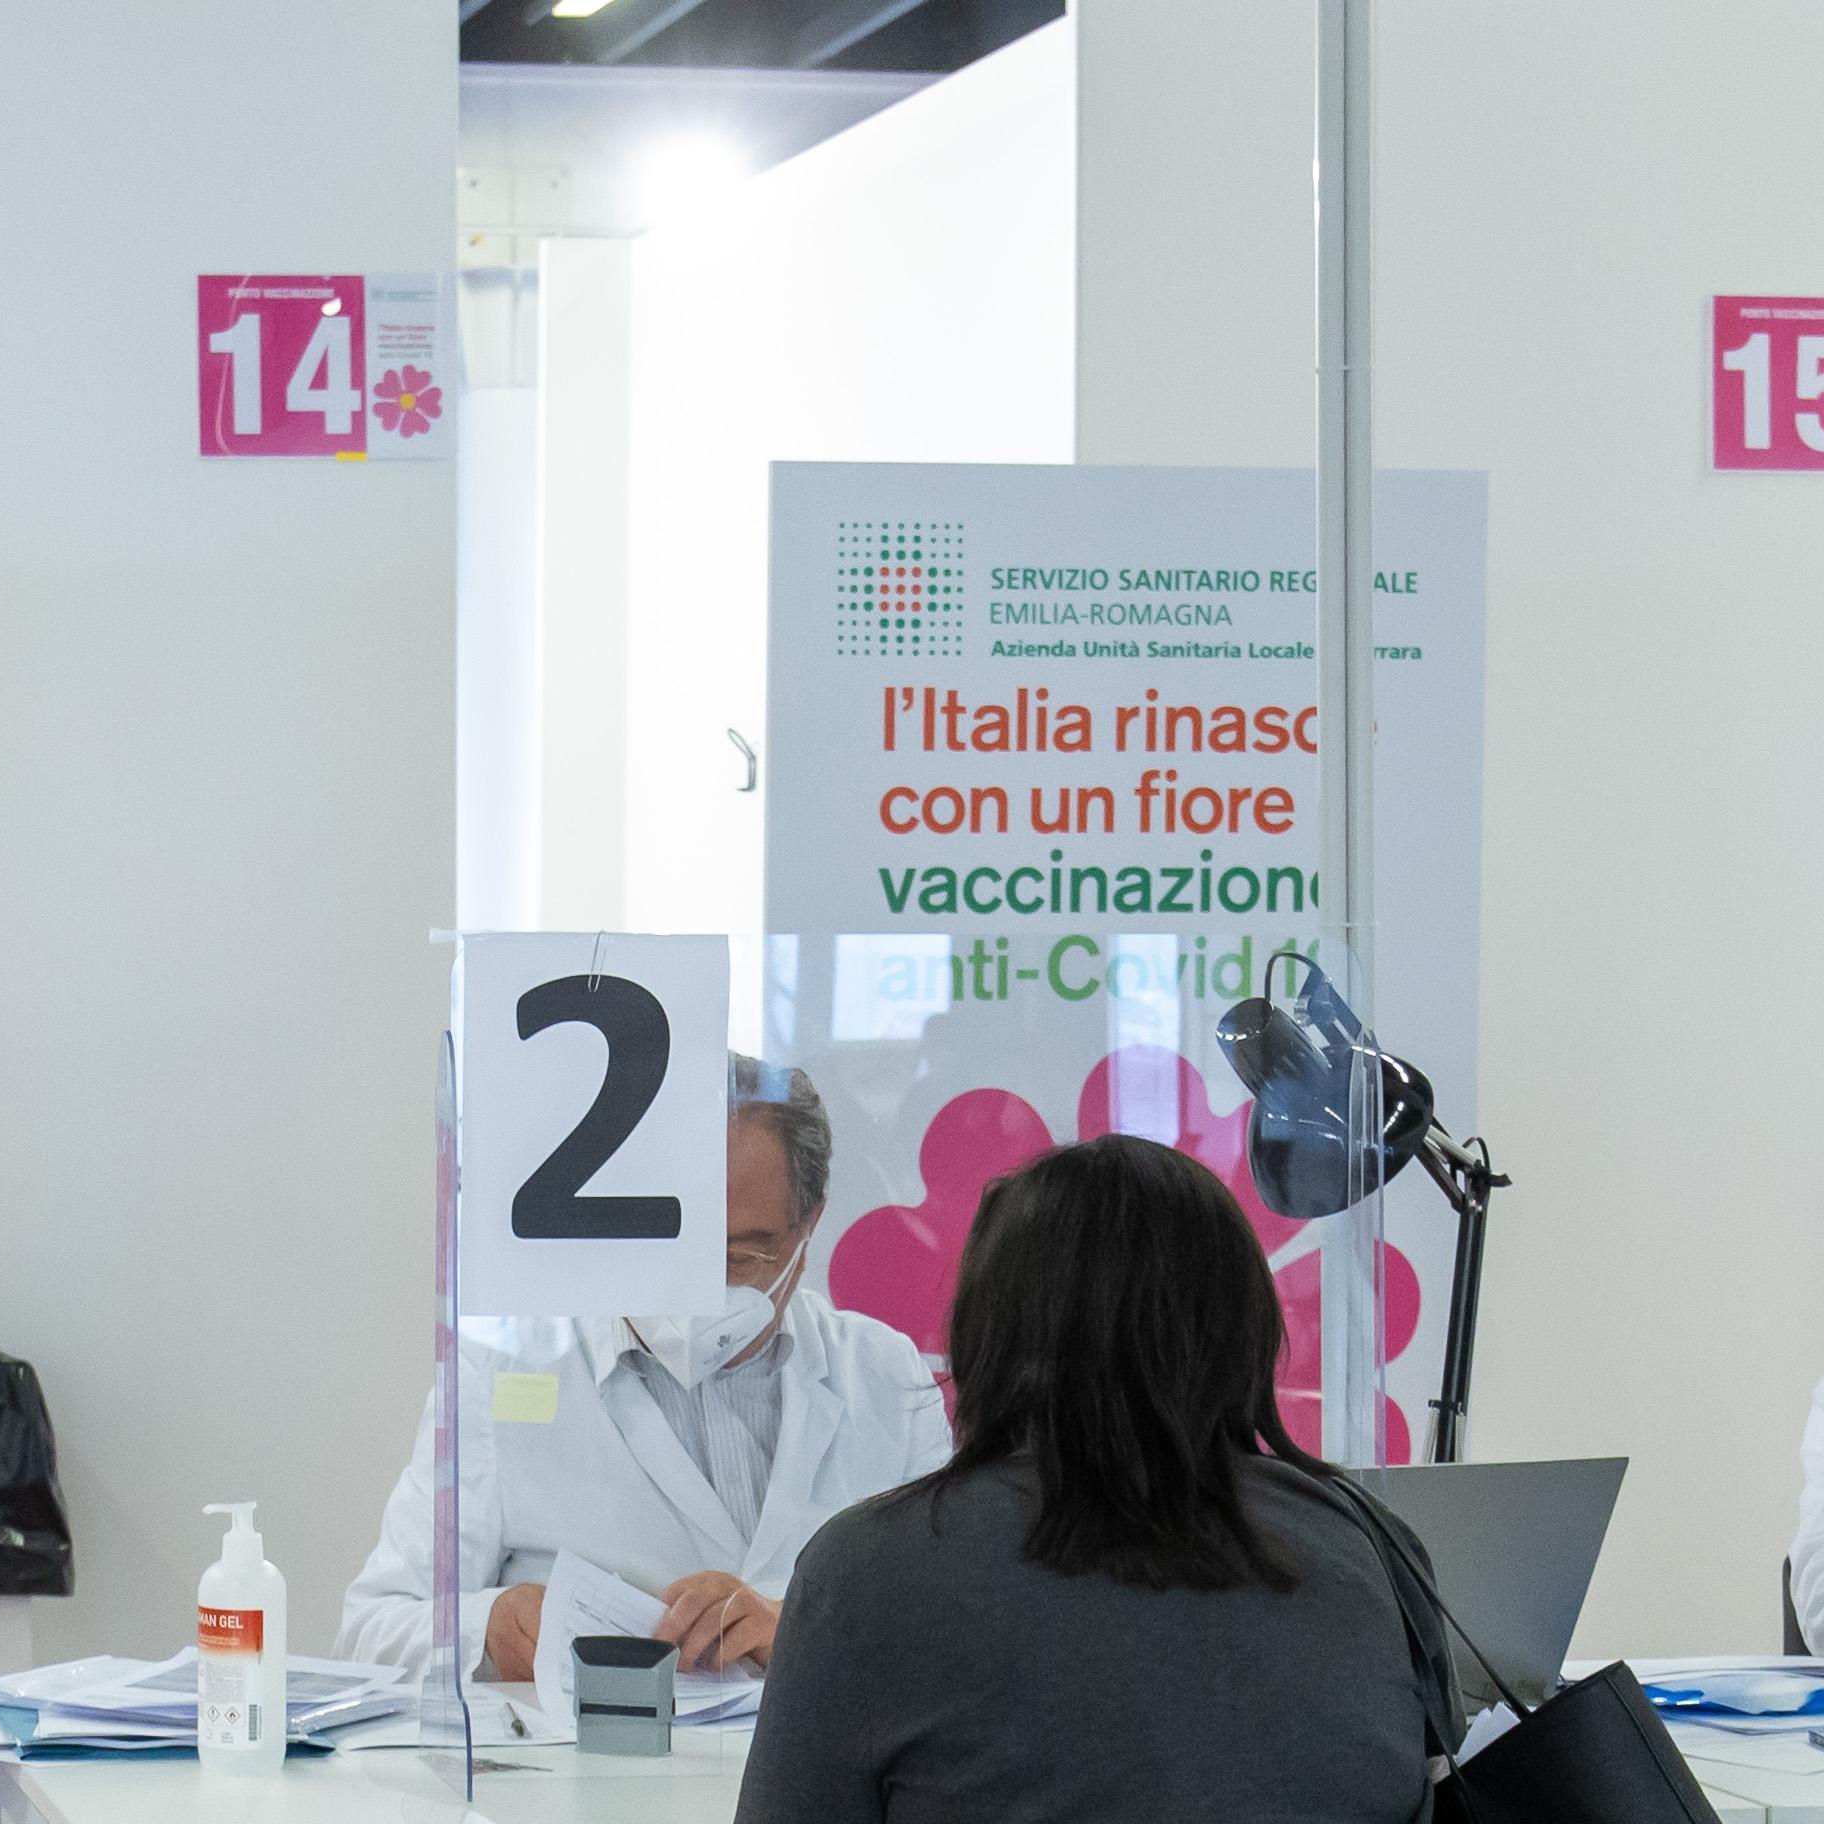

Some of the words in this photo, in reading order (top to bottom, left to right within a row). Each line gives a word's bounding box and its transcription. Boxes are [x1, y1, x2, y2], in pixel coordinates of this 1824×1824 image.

[210, 313, 362, 434] 14
[990, 567, 1110, 591] SERVIZIO
[1118, 568, 1261, 593] SANITARIO
[1269, 570, 1419, 595] REGALE
[989, 601, 1233, 627] EMILIA-ROMAGNA
[990, 639, 1077, 658] Azienda
[1083, 640, 1141, 658] Unità
[1146, 640, 1242, 659] Sanitaria
[1248, 641, 1315, 660] Locale
[1114, 688, 1317, 754] rinasc
[880, 787, 1008, 834] con
[1031, 787, 1114, 834] un
[1135, 769, 1294, 834] fiore
[878, 848, 1318, 914] vaccinazion
[879, 935, 1252, 1001] anti-Covid
[511, 975, 682, 1240] 2
[218, 1614, 245, 1631] GEL
